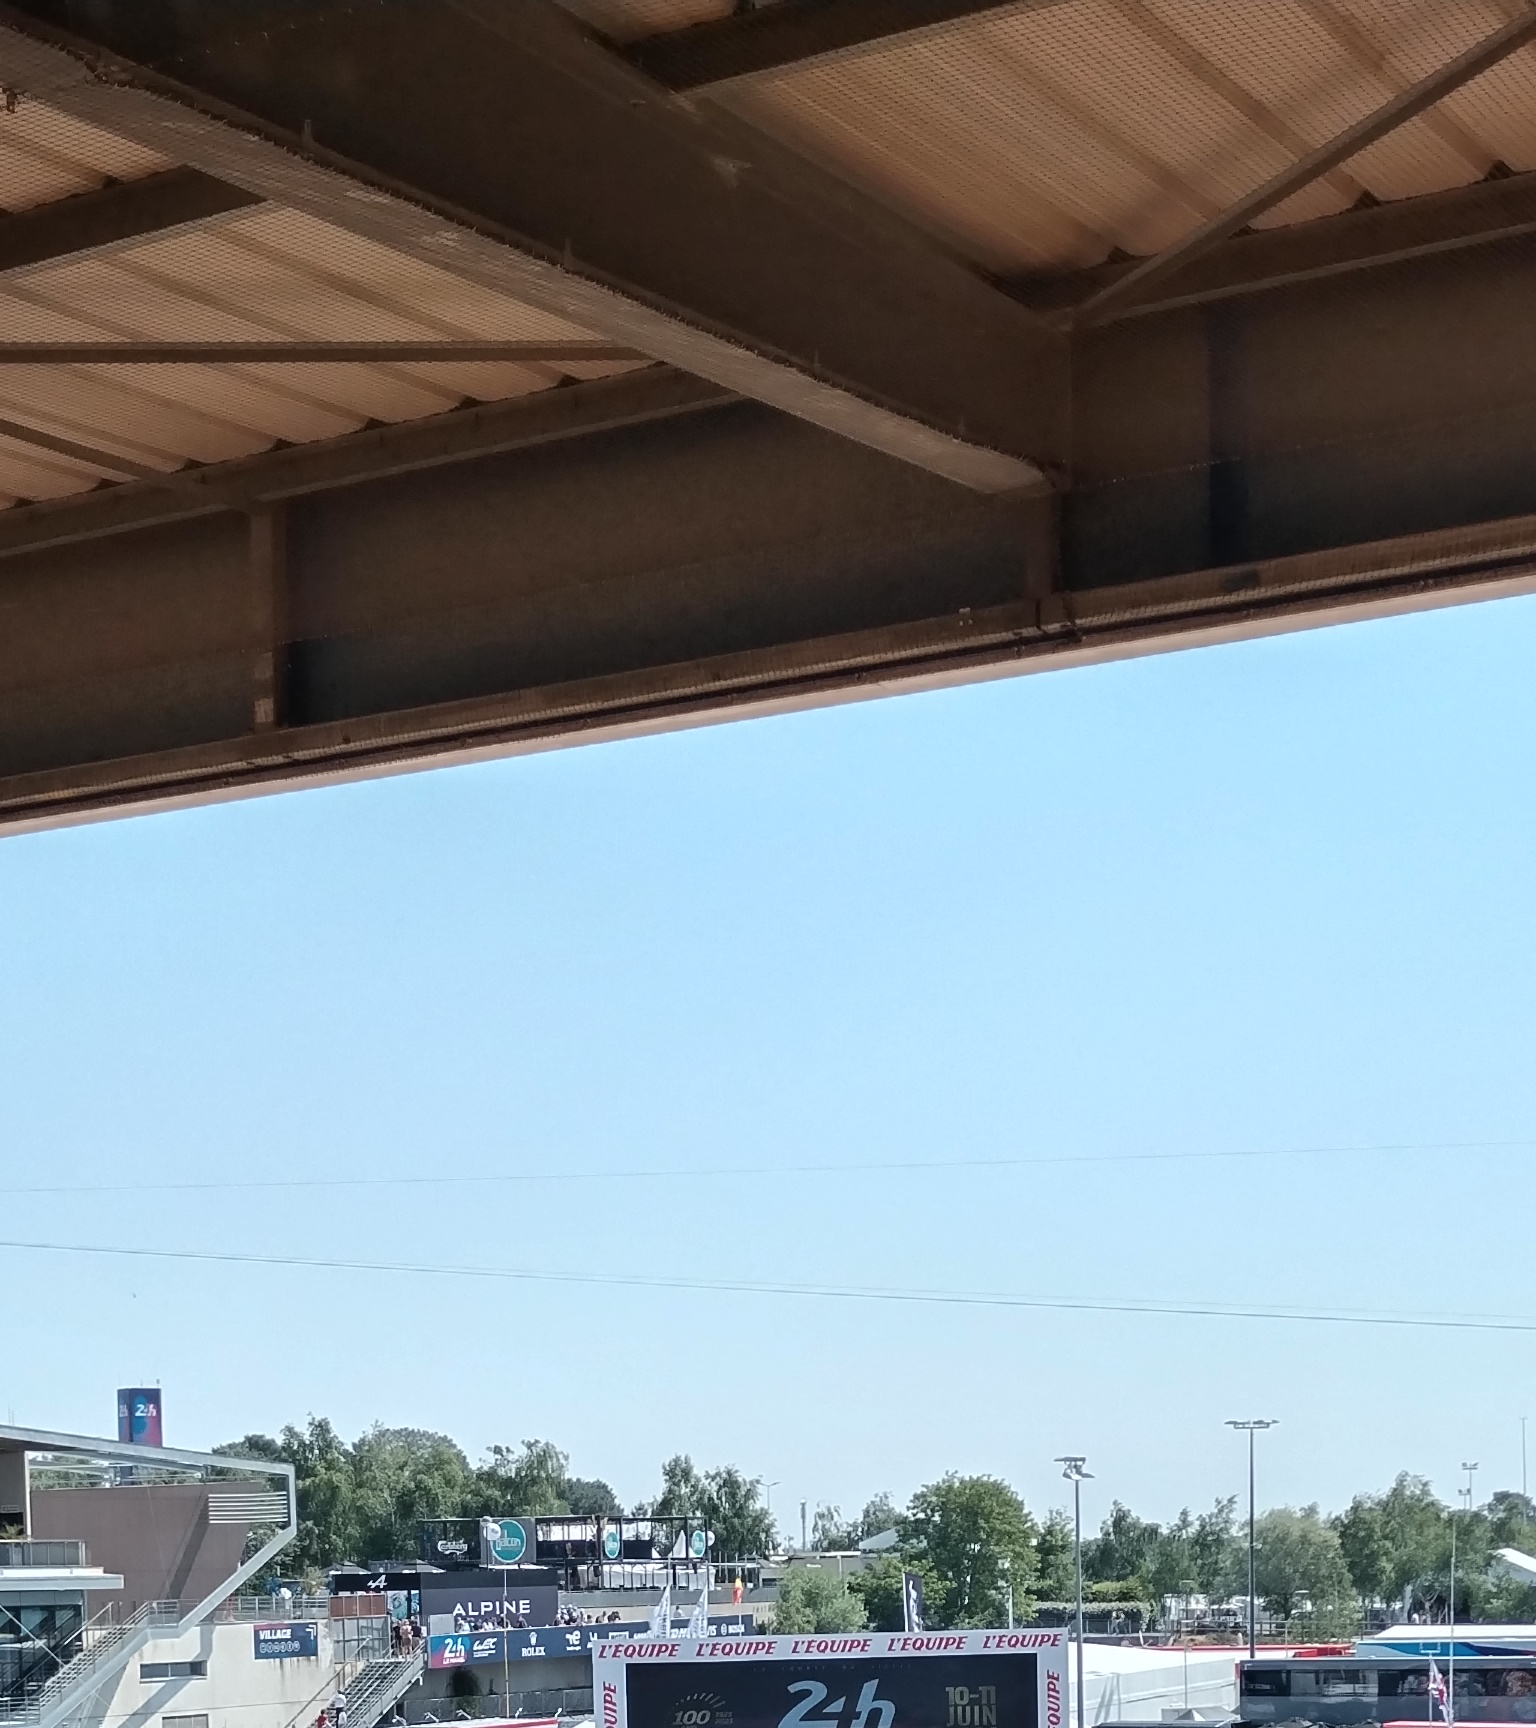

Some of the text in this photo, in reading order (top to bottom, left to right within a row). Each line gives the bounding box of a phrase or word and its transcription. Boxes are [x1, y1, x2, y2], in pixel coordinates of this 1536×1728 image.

[453, 1600, 531, 1616] ALPINE
[259, 1629, 292, 1640] VILLAGE
[444, 1637, 465, 1658] 24h
[522, 1647, 546, 1657] ROLEX
[945, 1685, 997, 1705] 10-11
[672, 1710, 711, 1726] 100
[946, 1705, 997, 1727] JUIN
